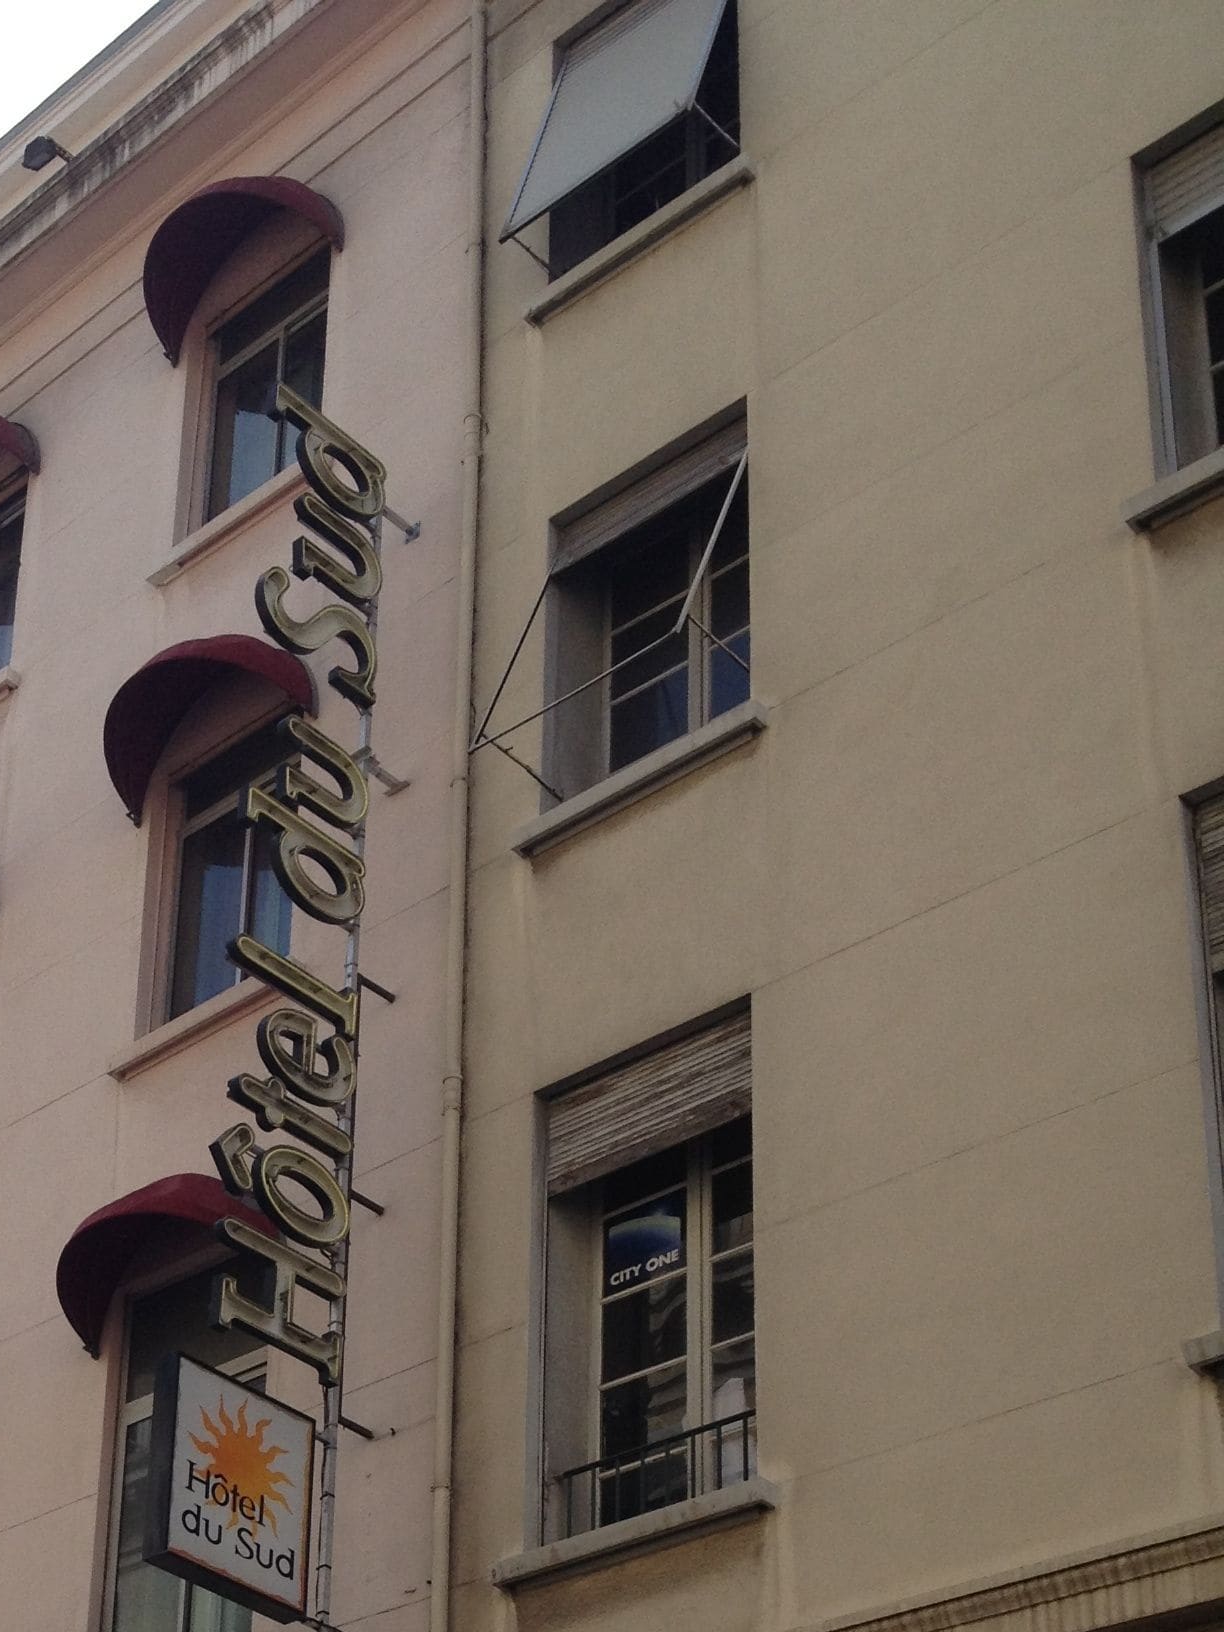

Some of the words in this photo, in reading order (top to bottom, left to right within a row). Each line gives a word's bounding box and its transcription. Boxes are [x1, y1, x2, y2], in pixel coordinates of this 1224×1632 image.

[254, 383, 387, 709] Sud
[242, 712, 369, 925] du
[209, 932, 360, 1388] Hôtel
[609, 1263, 642, 1286] CITY
[646, 1249, 680, 1273] ONE
[181, 1503, 222, 1546] du
[234, 1527, 296, 1581] Sud
[185, 1459, 266, 1527] Hôtel
